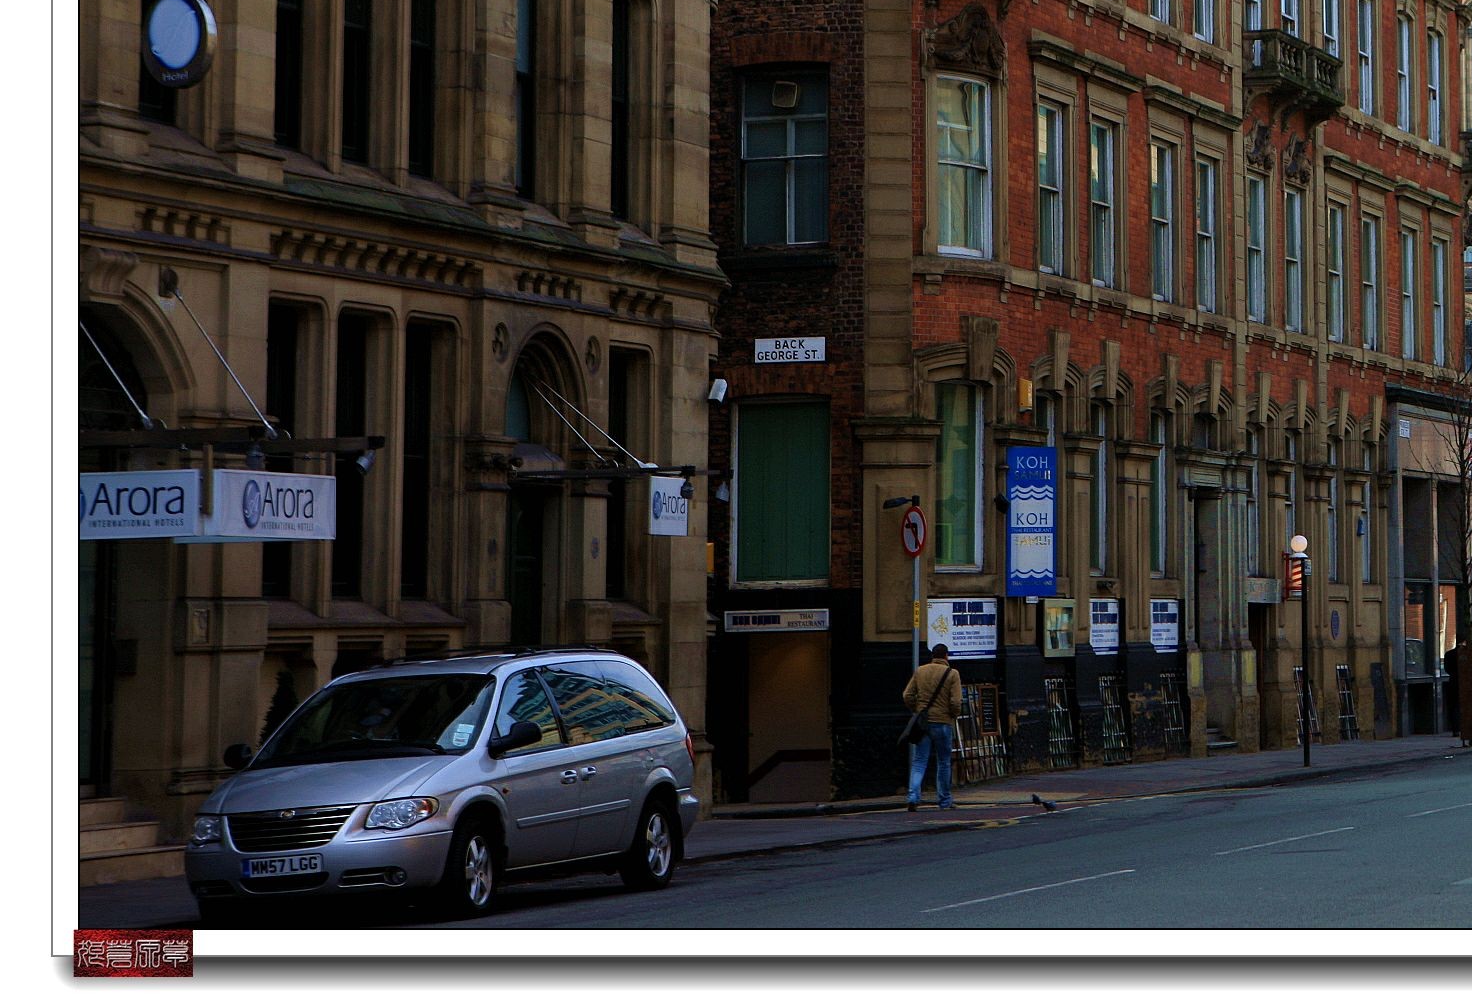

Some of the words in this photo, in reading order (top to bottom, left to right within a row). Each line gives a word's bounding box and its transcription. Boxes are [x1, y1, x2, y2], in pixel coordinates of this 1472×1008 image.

[775, 340, 805, 349] BACK
[757, 350, 799, 360] GEORGE
[804, 349, 820, 359] ST.
[1016, 456, 1048, 469] KOH
[89, 482, 185, 516] Arora
[261, 482, 314, 519] Arora
[663, 492, 686, 514] Arora
[88, 518, 152, 529] INTERNATIONAL
[154, 518, 184, 527] HOTELS
[1016, 513, 1048, 525] KOH
[251, 859, 286, 875] MM57
[289, 856, 318, 872] LGG
